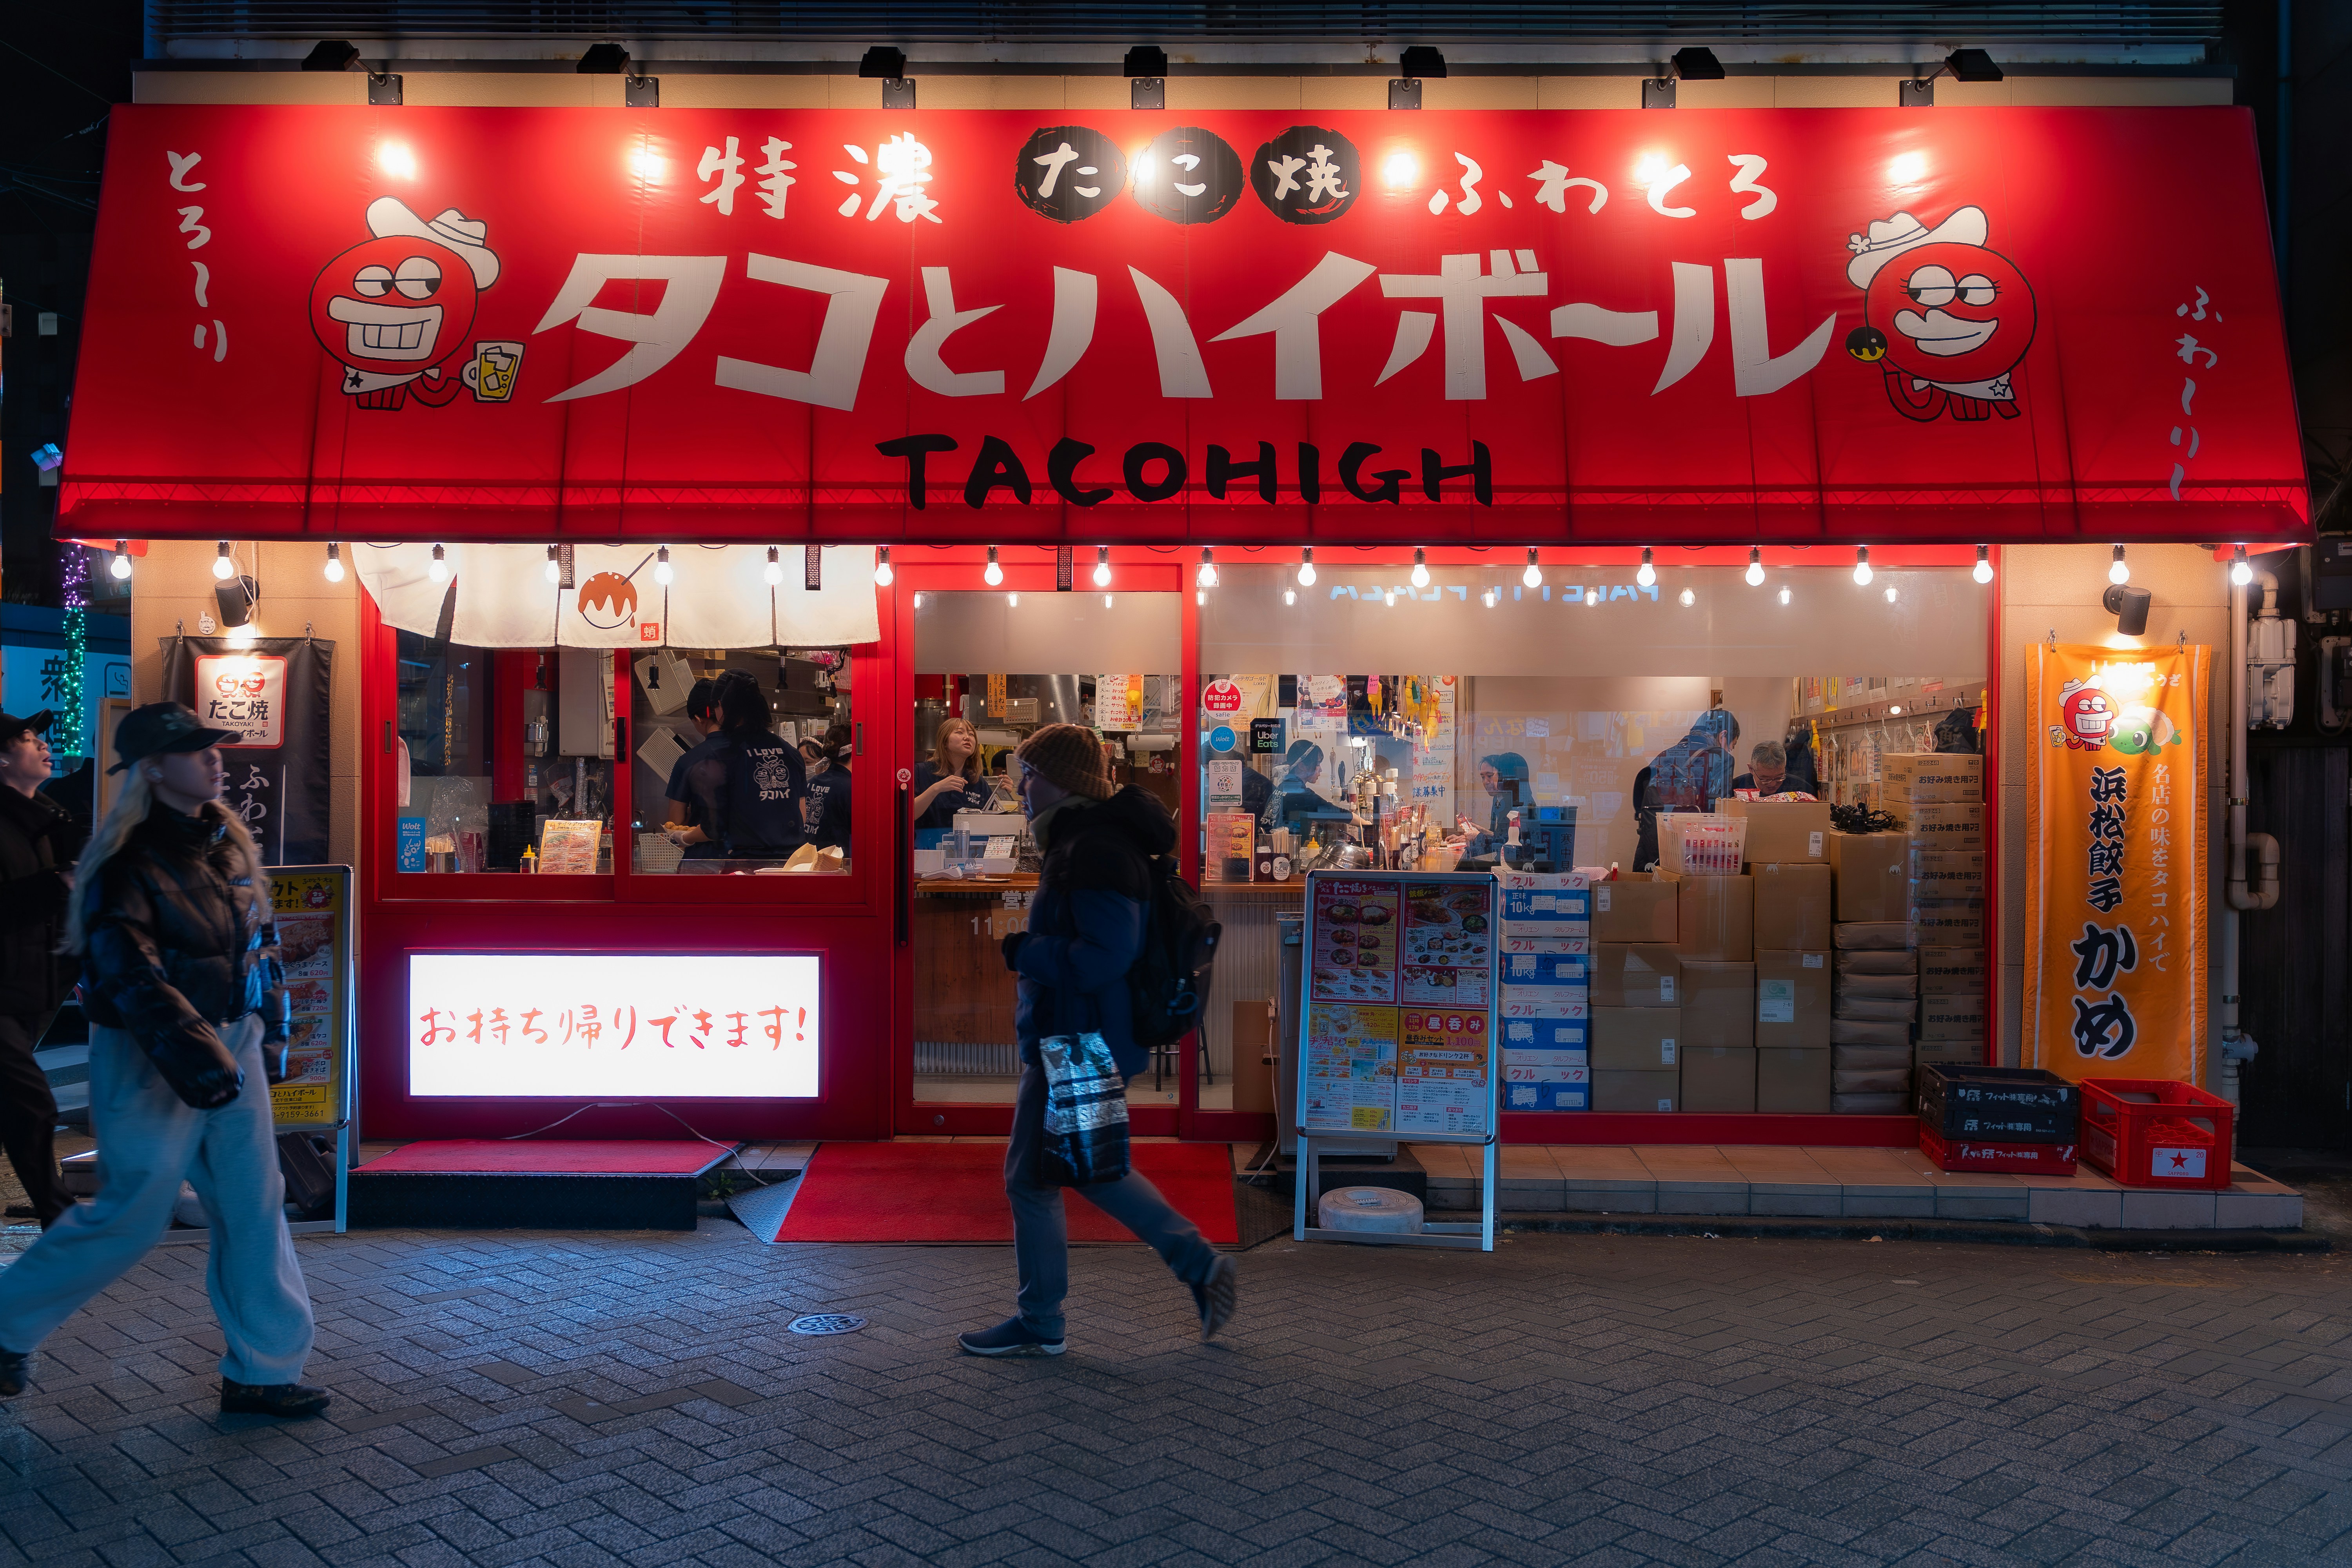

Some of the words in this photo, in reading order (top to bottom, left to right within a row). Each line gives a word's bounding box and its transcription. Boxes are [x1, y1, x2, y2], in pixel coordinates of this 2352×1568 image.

[697, 132, 942, 223] 特濃
[1033, 142, 1350, 203] たこ焼
[1428, 152, 1777, 219] ふわとろ
[167, 151, 227, 362] とろーり
[532, 249, 1837, 412] タコとハイボール
[875, 434, 1492, 511] TACOHIGH
[209, 700, 269, 720] たこ焼
[755, 747, 784, 756] LOVE
[1918, 775, 1978, 784] お好み焼き用マヨ
[759, 788, 791, 801] タコハイ
[1920, 823, 1980, 832] お好み焼き用マヨ
[2086, 766, 2127, 913] 浜松餃子
[2149, 763, 2171, 972] 名店の味をタコハイで
[1510, 876, 1535, 887] クル
[1561, 877, 1583, 887] ック
[1921, 871, 1982, 880] お好み焼き用マヨ
[1510, 902, 1535, 915] 10kg
[1919, 918, 1979, 927] お好み焼き用マヨ
[1510, 940, 1535, 952] クル
[1561, 940, 1584, 952] ック
[2070, 921, 2139, 1060] かめ
[1509, 1005, 1534, 1016] クル
[1560, 1005, 1583, 1016] ック
[420, 1004, 807, 1051] お持ち帰りできます!
[1428, 1017, 1480, 1031] 昼呑み
[1446, 1035, 1481, 1047] 1,100円
[1510, 1069, 1535, 1080] クル
[1561, 1069, 1584, 1080] ック
